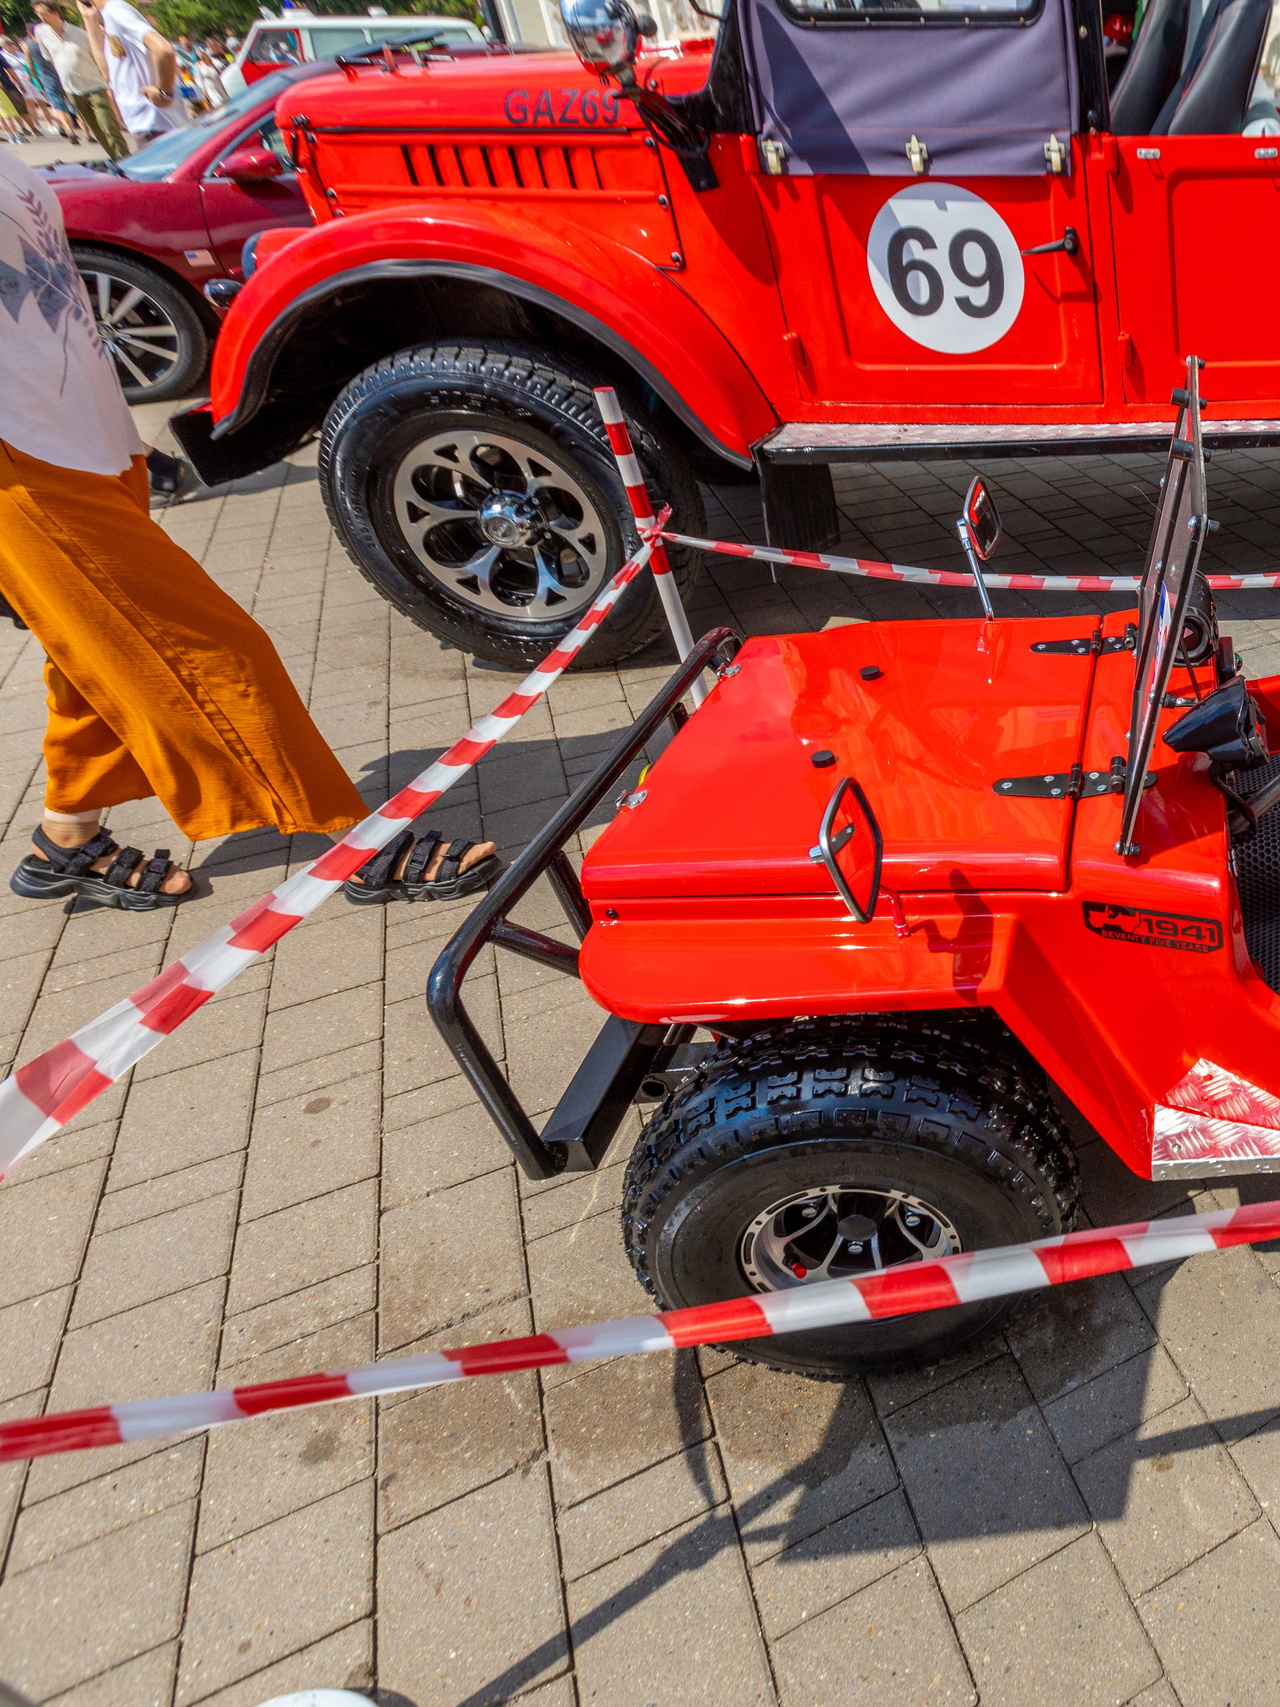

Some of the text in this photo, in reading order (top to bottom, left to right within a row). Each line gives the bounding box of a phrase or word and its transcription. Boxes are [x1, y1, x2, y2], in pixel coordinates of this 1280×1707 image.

[505, 88, 620, 124] GAZ69
[887, 225, 1005, 318] 69
[1101, 931, 1209, 953] SEVENTY FIVE YEARS
[1142, 918, 1216, 942] 1941
